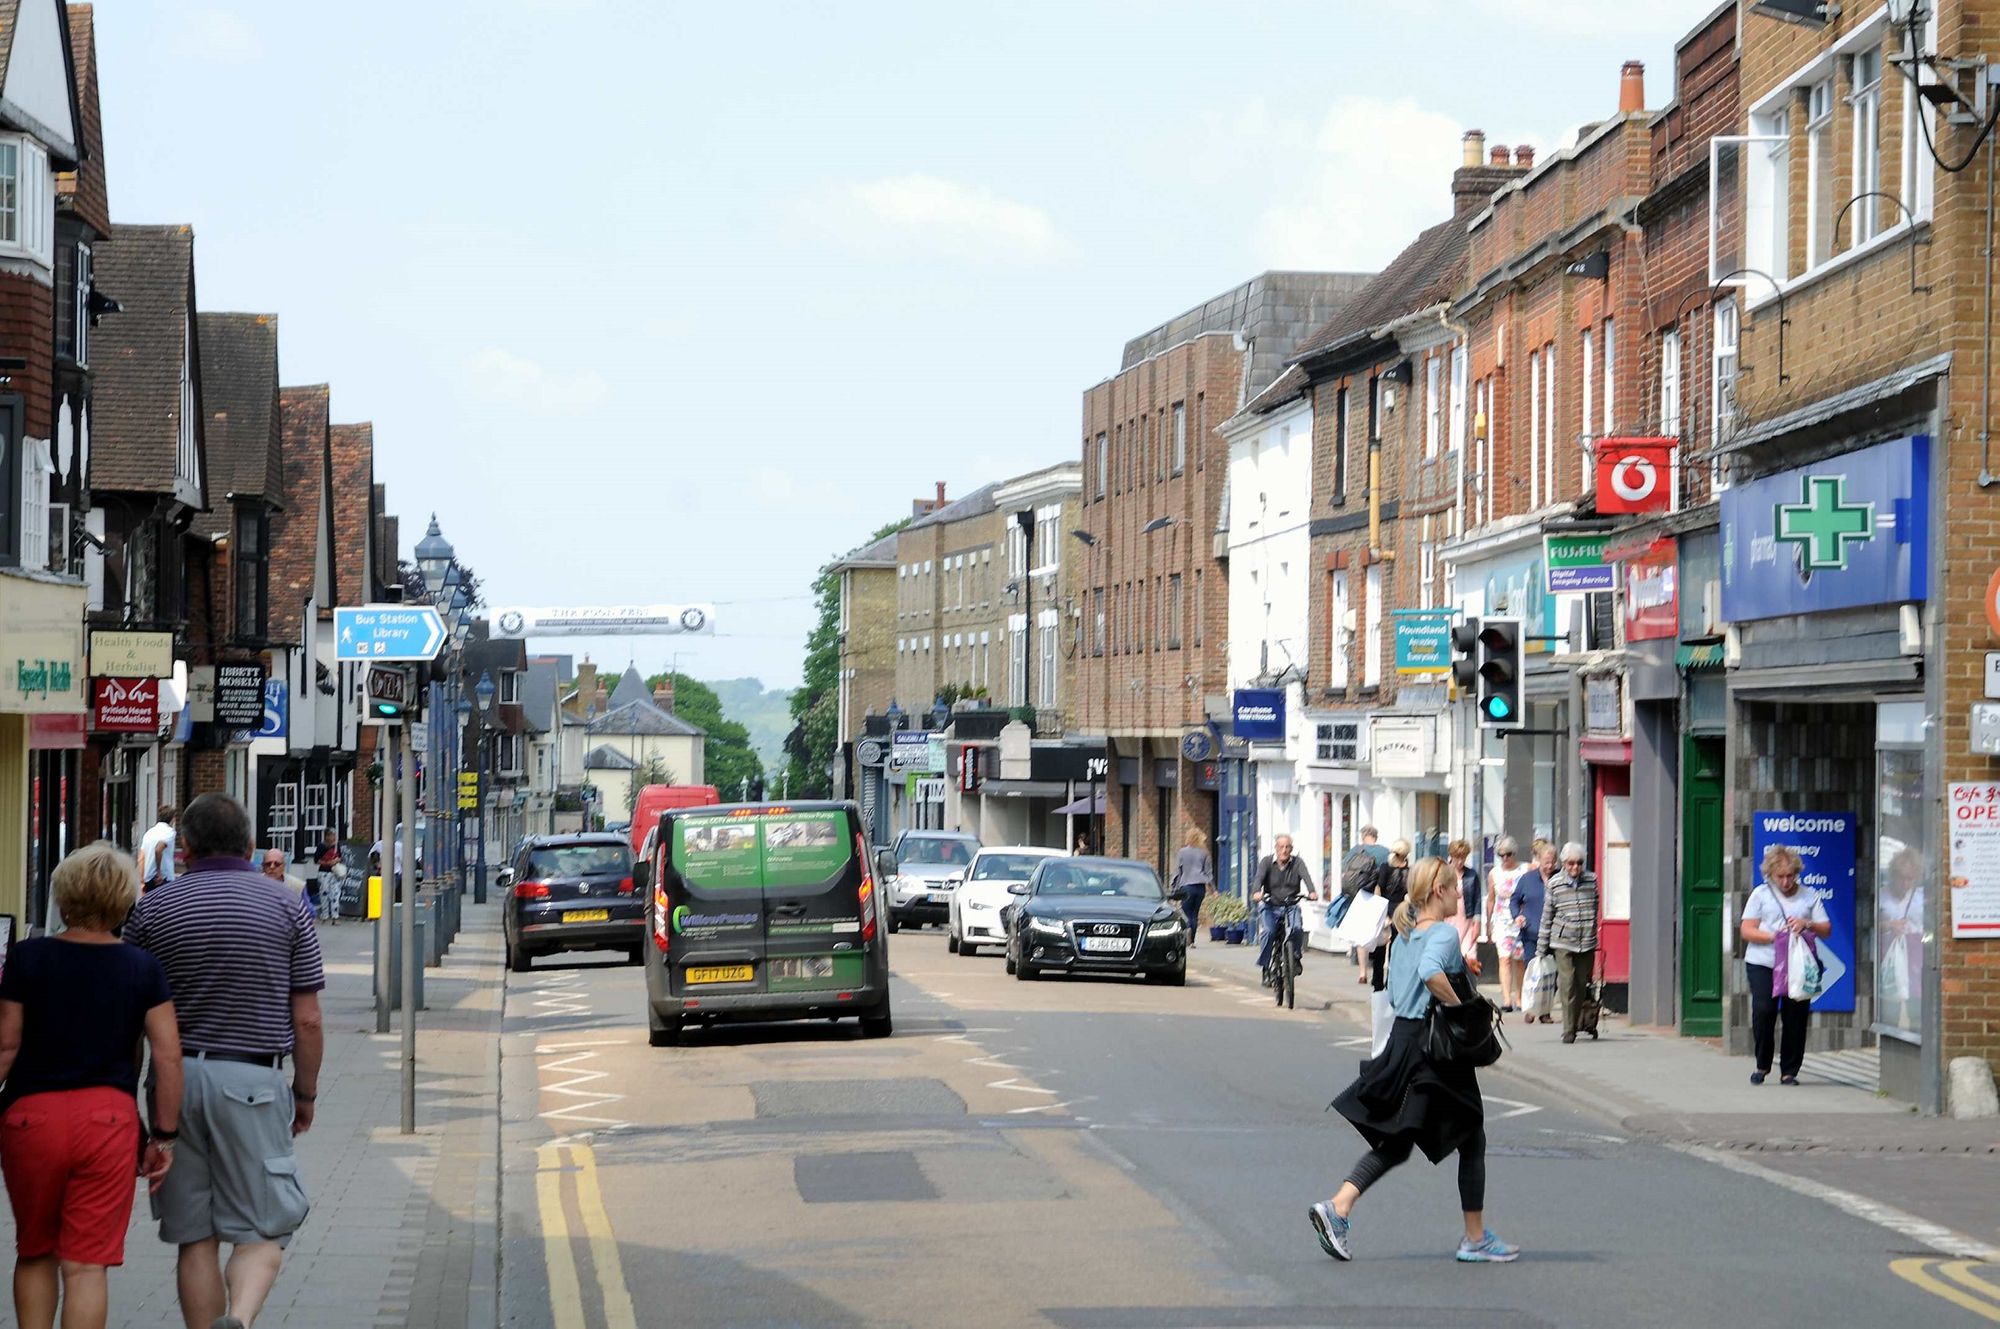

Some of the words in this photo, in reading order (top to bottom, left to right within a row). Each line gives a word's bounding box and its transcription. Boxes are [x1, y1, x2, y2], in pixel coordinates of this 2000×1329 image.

[1551, 569, 1577, 578] Digital
[1552, 577, 1582, 586] Imaging
[1581, 576, 1610, 584] Service
[355, 613, 376, 625] Bus
[379, 612, 418, 625] Station
[373, 627, 409, 640] Library
[1398, 624, 1447, 635] Poundland
[94, 636, 133, 647] Health
[135, 637, 170, 649] Foods
[126, 649, 137, 659] &
[105, 661, 157, 673] Herbalist
[220, 666, 261, 677] IBBETT
[101, 705, 128, 714] British
[128, 705, 152, 715] Heart
[101, 714, 152, 724] Foundation
[1763, 815, 1846, 833] welcome
